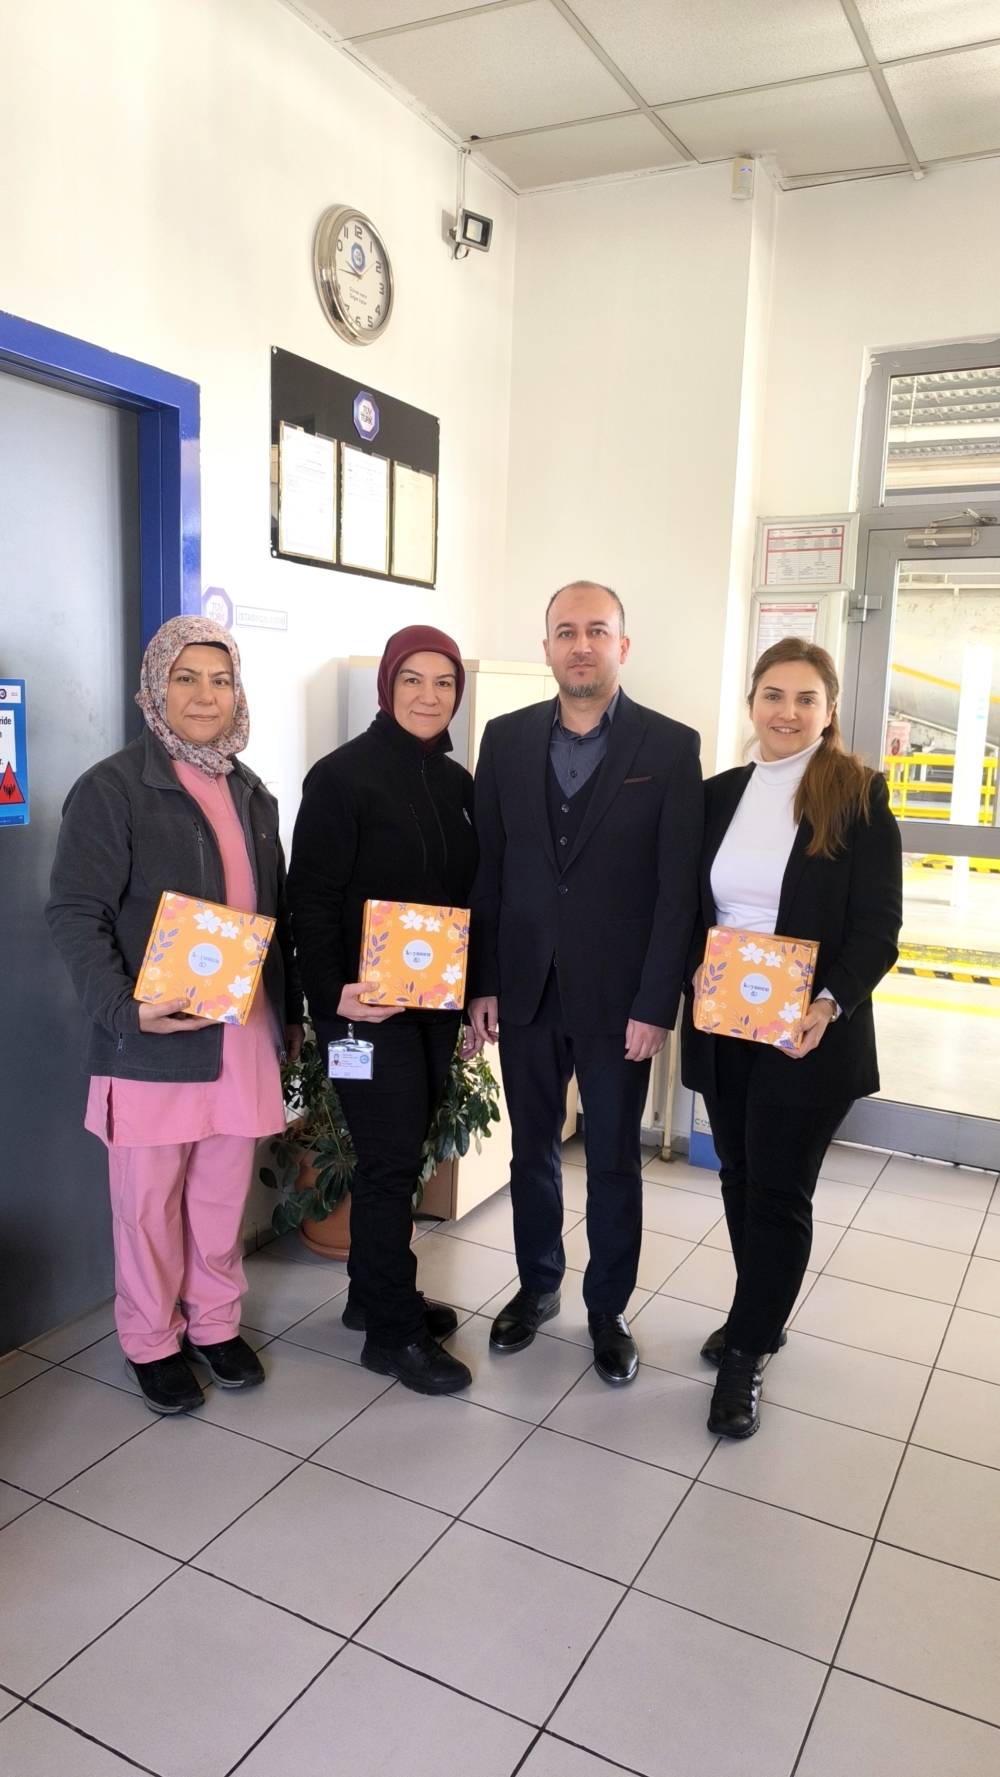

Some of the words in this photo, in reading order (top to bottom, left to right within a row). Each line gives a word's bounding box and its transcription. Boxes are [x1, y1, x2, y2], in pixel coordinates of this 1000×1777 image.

[355, 225, 362, 240] 12
[376, 260, 381, 274] 2
[379, 282, 384, 295] 3
[375, 304, 381, 316] 4
[368, 315, 373, 328] 5
[238, 610, 268, 624] İSTASYON
